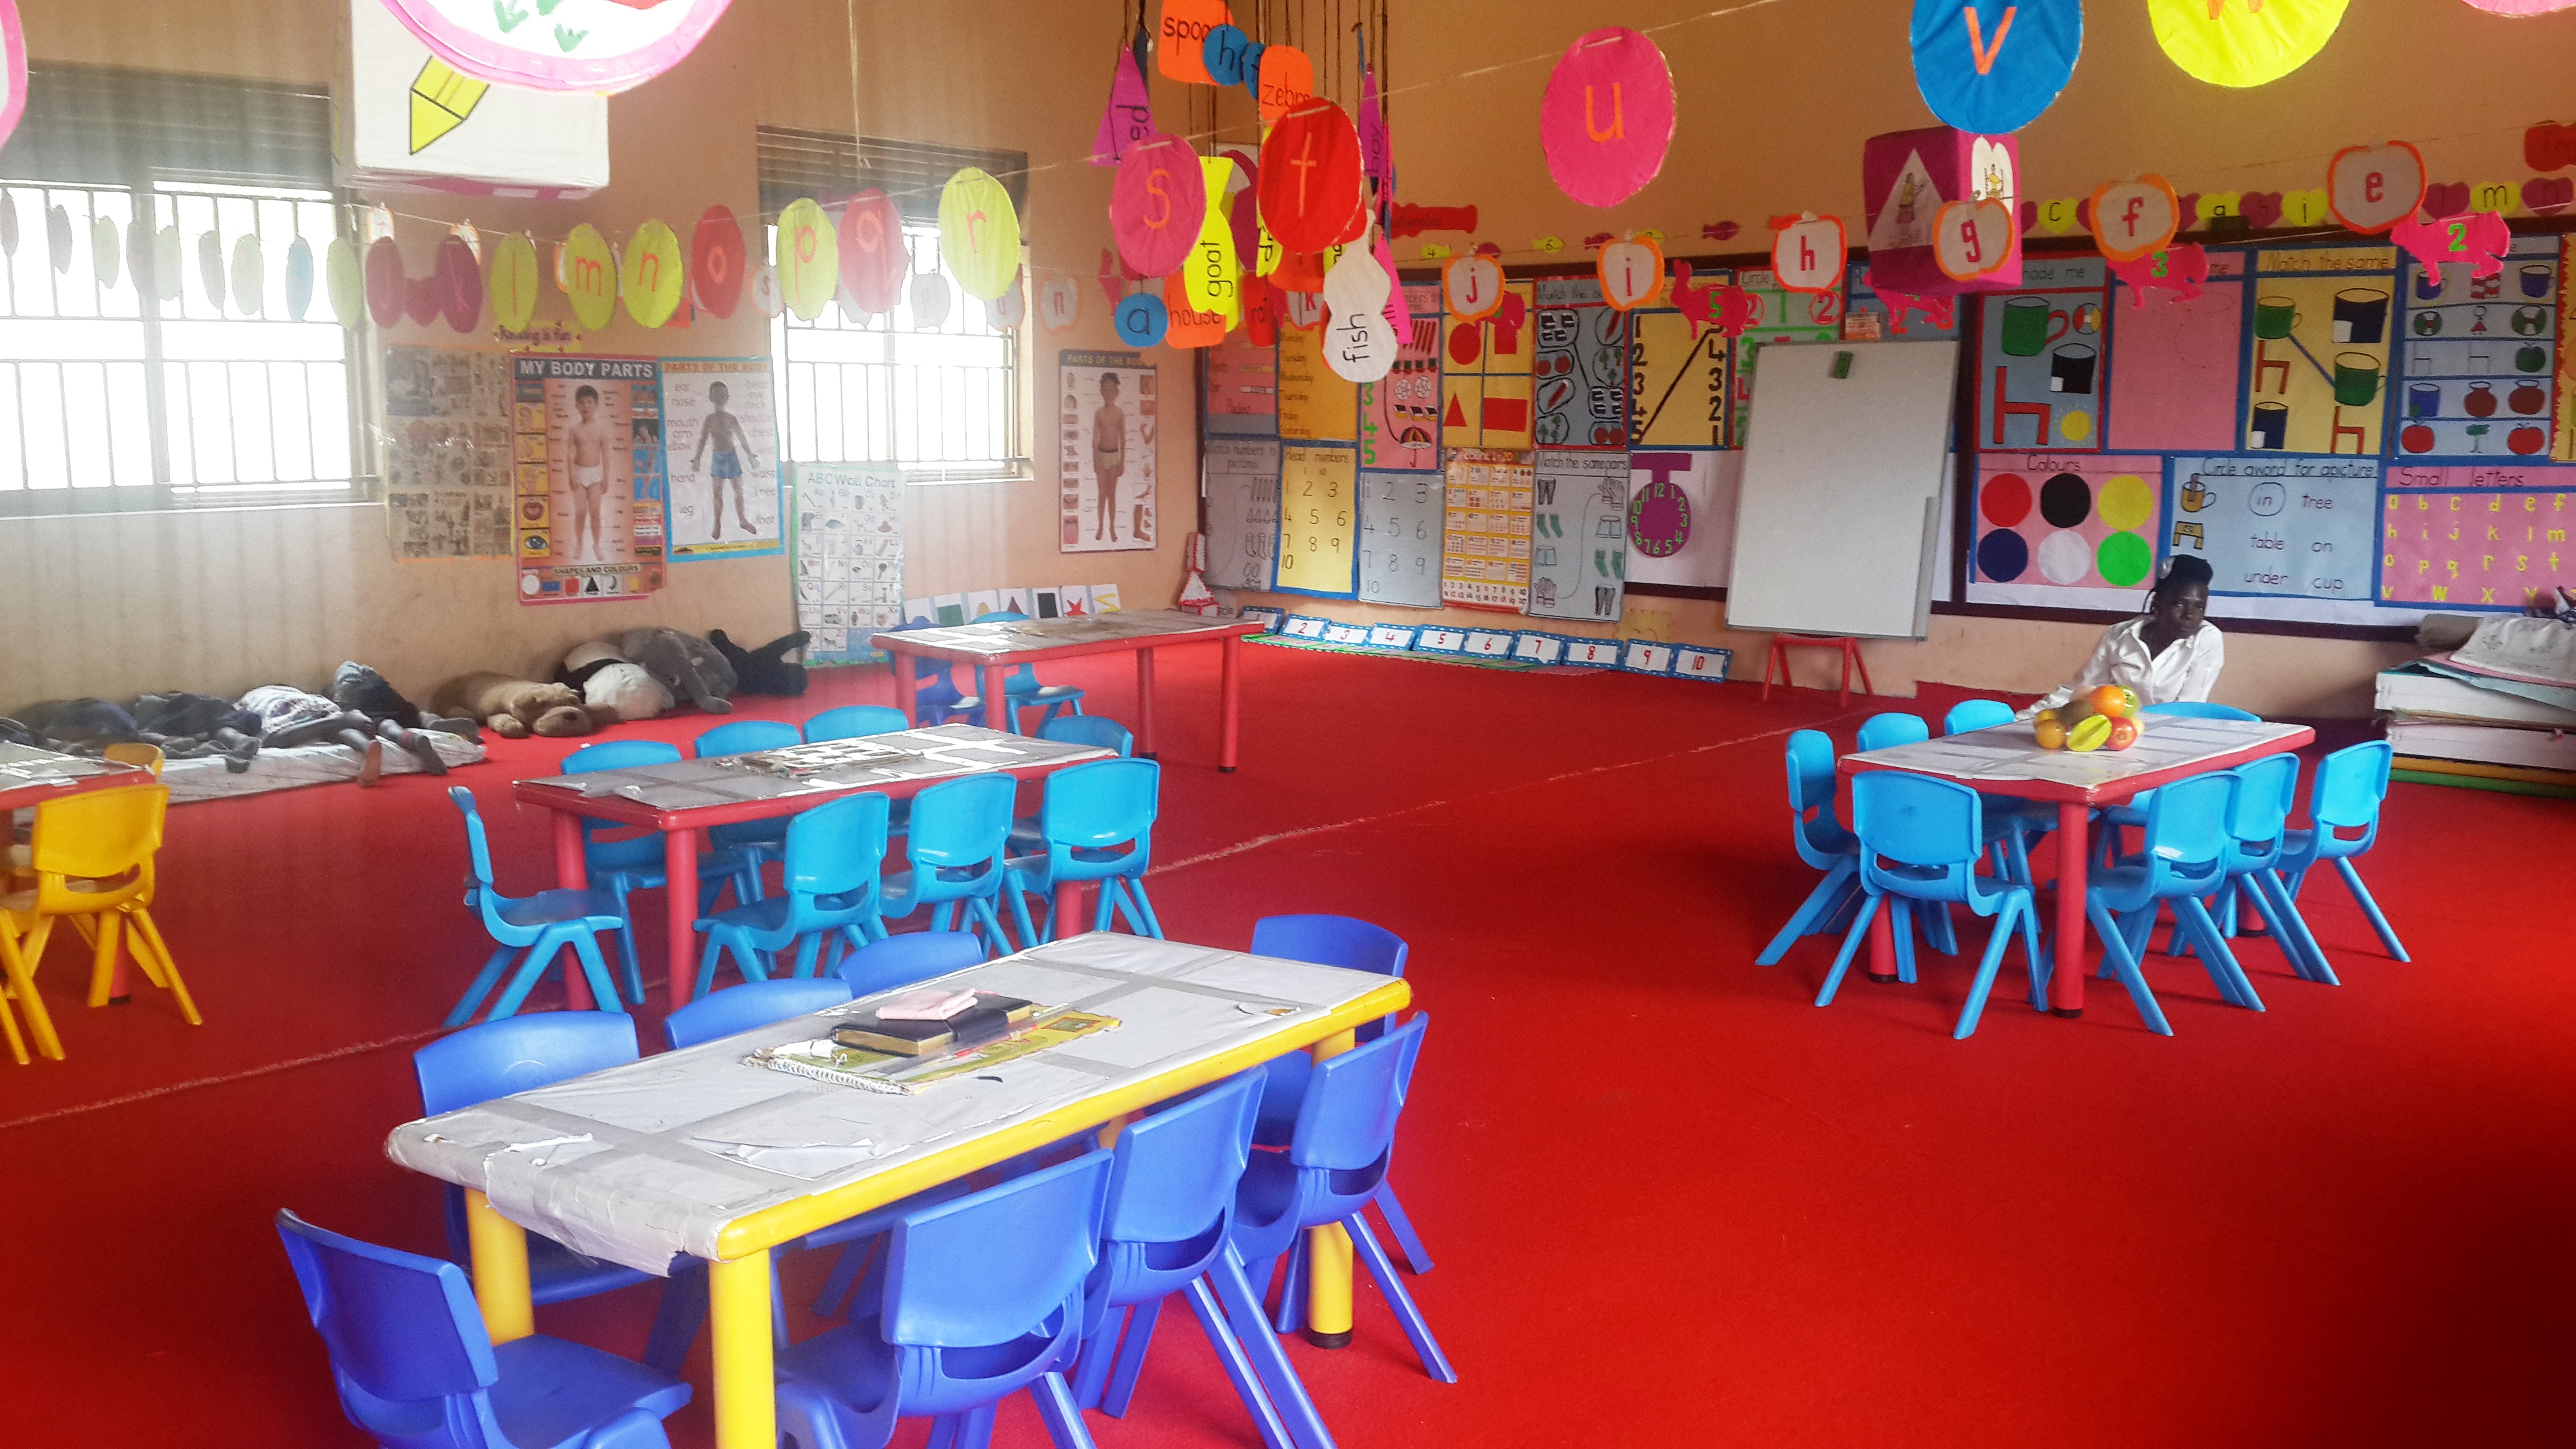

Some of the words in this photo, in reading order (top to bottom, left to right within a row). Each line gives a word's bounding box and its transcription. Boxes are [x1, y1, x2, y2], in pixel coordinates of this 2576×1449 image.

[1163, 16, 1212, 56] spoo
[1964, 6, 2016, 75] v
[1116, 104, 1150, 142] ed
[1584, 82, 1624, 144] u
[1289, 132, 1317, 218] t
[2366, 172, 2383, 203] e
[2483, 184, 2508, 208] m
[2122, 197, 2144, 237] f
[965, 209, 987, 255] r
[1959, 219, 1982, 263] g
[2447, 224, 2467, 252] 2
[794, 224, 817, 304] p
[1800, 235, 1816, 271] h
[2151, 251, 2169, 278] 3
[575, 255, 602, 296] m
[638, 250, 659, 292] n
[1202, 238, 1234, 298] goat
[1625, 256, 1633, 296] i
[1466, 266, 1478, 304] j
[1054, 291, 1065, 316] n
[1709, 291, 1723, 318] 5
[1817, 293, 1835, 323] 2
[1126, 308, 1151, 336] a
[1336, 312, 1370, 363] fish
[1632, 343, 1649, 367] 2
[1708, 338, 1726, 361] 4
[519, 359, 545, 374] MY
[550, 361, 597, 376] BODY
[601, 363, 653, 378] PARTS
[1632, 372, 1645, 396] 3
[1708, 367, 1724, 392] 3
[1362, 381, 1375, 407] 3
[1708, 395, 1722, 421] 2
[1362, 411, 1378, 437] 4
[1363, 439, 1377, 464] 5
[2027, 454, 2081, 472] Colours
[807, 472, 834, 485] ABC
[864, 474, 895, 489] Chart
[2399, 466, 2449, 486] Small
[2468, 466, 2525, 487] letters
[1302, 480, 1313, 496] 2
[1327, 482, 1338, 498] 3
[1382, 481, 1396, 501] 2
[1415, 482, 1428, 504] 3
[1654, 482, 1666, 498] 12
[1677, 496, 1686, 512] 2
[2257, 493, 2272, 507] in
[2302, 494, 2334, 510] tree
[2388, 494, 2399, 510] a
[2419, 495, 2429, 511] b
[2449, 495, 2462, 512] c
[2489, 493, 2502, 512] d
[2525, 496, 2537, 512] e
[2552, 493, 2567, 512] f
[1284, 507, 1292, 522] 4
[1309, 509, 1320, 525] 5
[1336, 510, 1347, 527] 6
[1388, 517, 1401, 537] 5
[1415, 519, 1427, 540] 6
[1631, 514, 1639, 530] 9
[1680, 512, 1689, 528] 3
[1634, 530, 1643, 546] 8
[2250, 531, 2285, 550] table
[2387, 523, 2398, 539] h
[2447, 521, 2461, 540] j
[2487, 525, 2500, 541] k
[2547, 529, 2567, 542] m
[1282, 533, 1291, 548] 7
[1309, 536, 1318, 552] 8
[1330, 537, 1340, 554] 9
[1644, 538, 1651, 554] 7
[1653, 539, 1661, 555] 6
[1664, 539, 1673, 555] 5
[1281, 554, 1295, 570] 10
[1362, 549, 1372, 569] 7
[1388, 553, 1399, 572] 8
[1415, 557, 1427, 576] 9
[2384, 553, 2396, 567] o
[2418, 559, 2430, 575] p
[2446, 559, 2460, 580] q
[2483, 554, 2496, 572] r
[2515, 554, 2529, 572] s
[1367, 580, 1380, 594] 10
[2244, 564, 2289, 585] under
[2312, 577, 2344, 595] cup
[2381, 584, 2395, 599] v
[2481, 585, 2496, 604] x
[1299, 622, 1308, 634] 2
[1340, 630, 1350, 640] 3
[1385, 631, 1395, 642] 4
[1437, 633, 1445, 645] 5
[1484, 637, 1492, 651] 6
[1534, 640, 1543, 654] 7
[1587, 645, 1596, 660] 8
[1643, 649, 1651, 665] 9
[1692, 655, 1704, 671] 10
